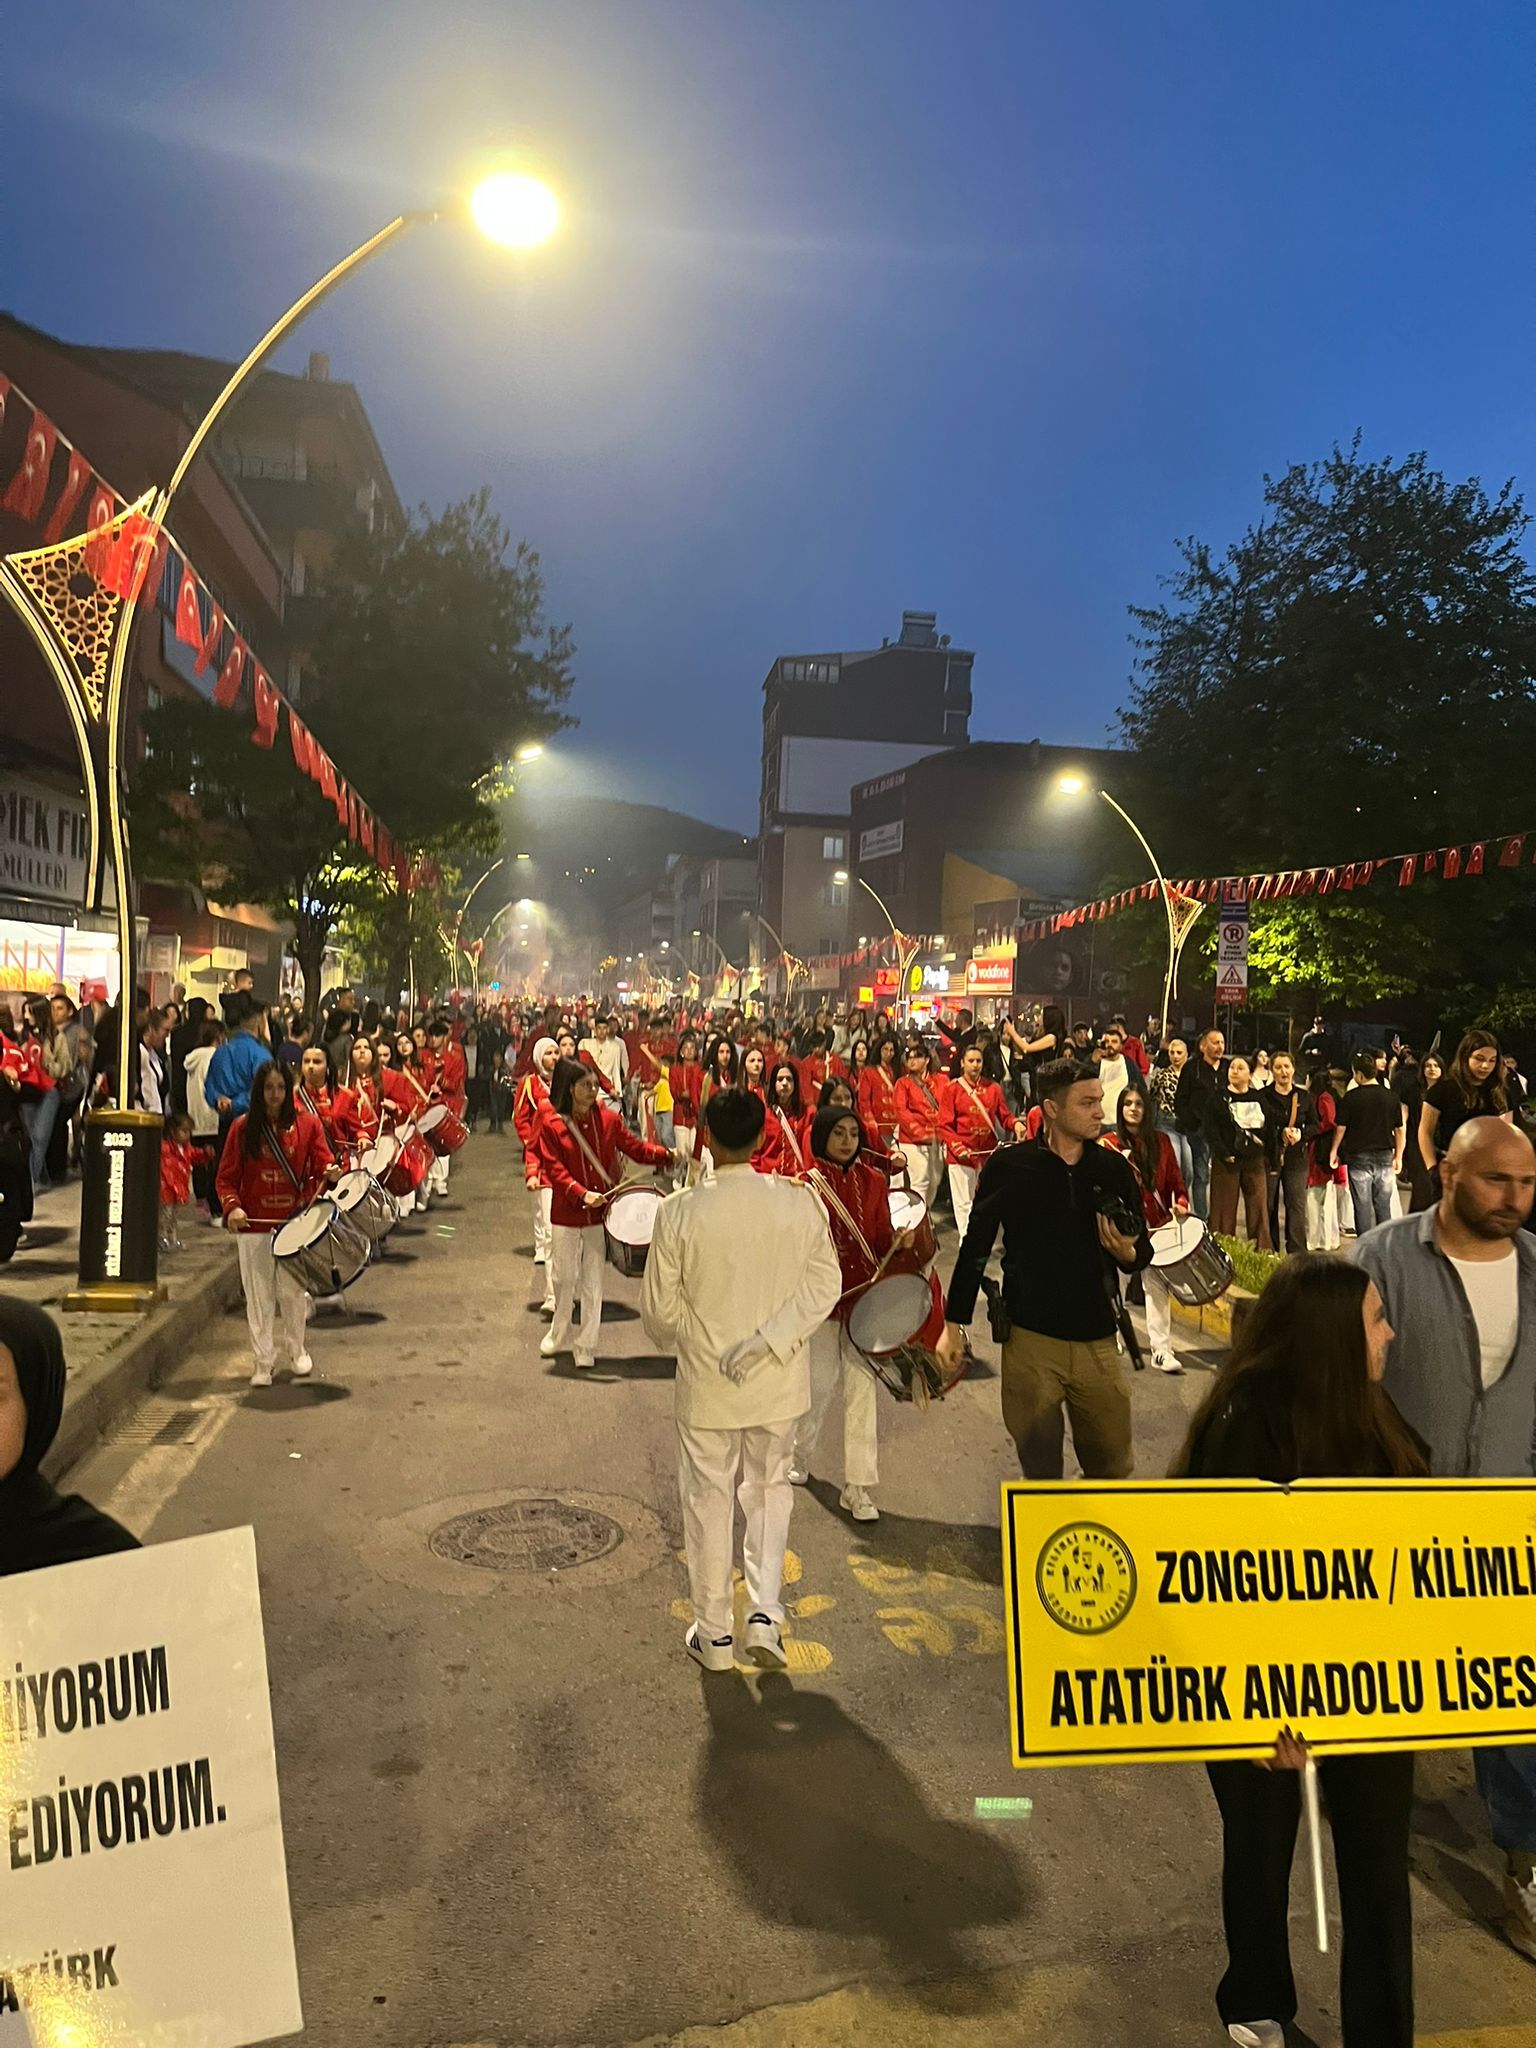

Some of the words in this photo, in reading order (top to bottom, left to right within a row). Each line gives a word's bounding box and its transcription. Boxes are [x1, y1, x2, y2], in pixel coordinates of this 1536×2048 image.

[978, 963, 1010, 979] vodafone
[103, 1132, 134, 1147] 2023
[1156, 1548, 1380, 1604] ZONGULDAK
[1409, 1535, 1536, 1599] KİLİMLİ
[1050, 1654, 1232, 1727] ATATÜRK
[1243, 1658, 1425, 1720] ANADOLU
[9, 1757, 227, 1871] EDİYORUM.
